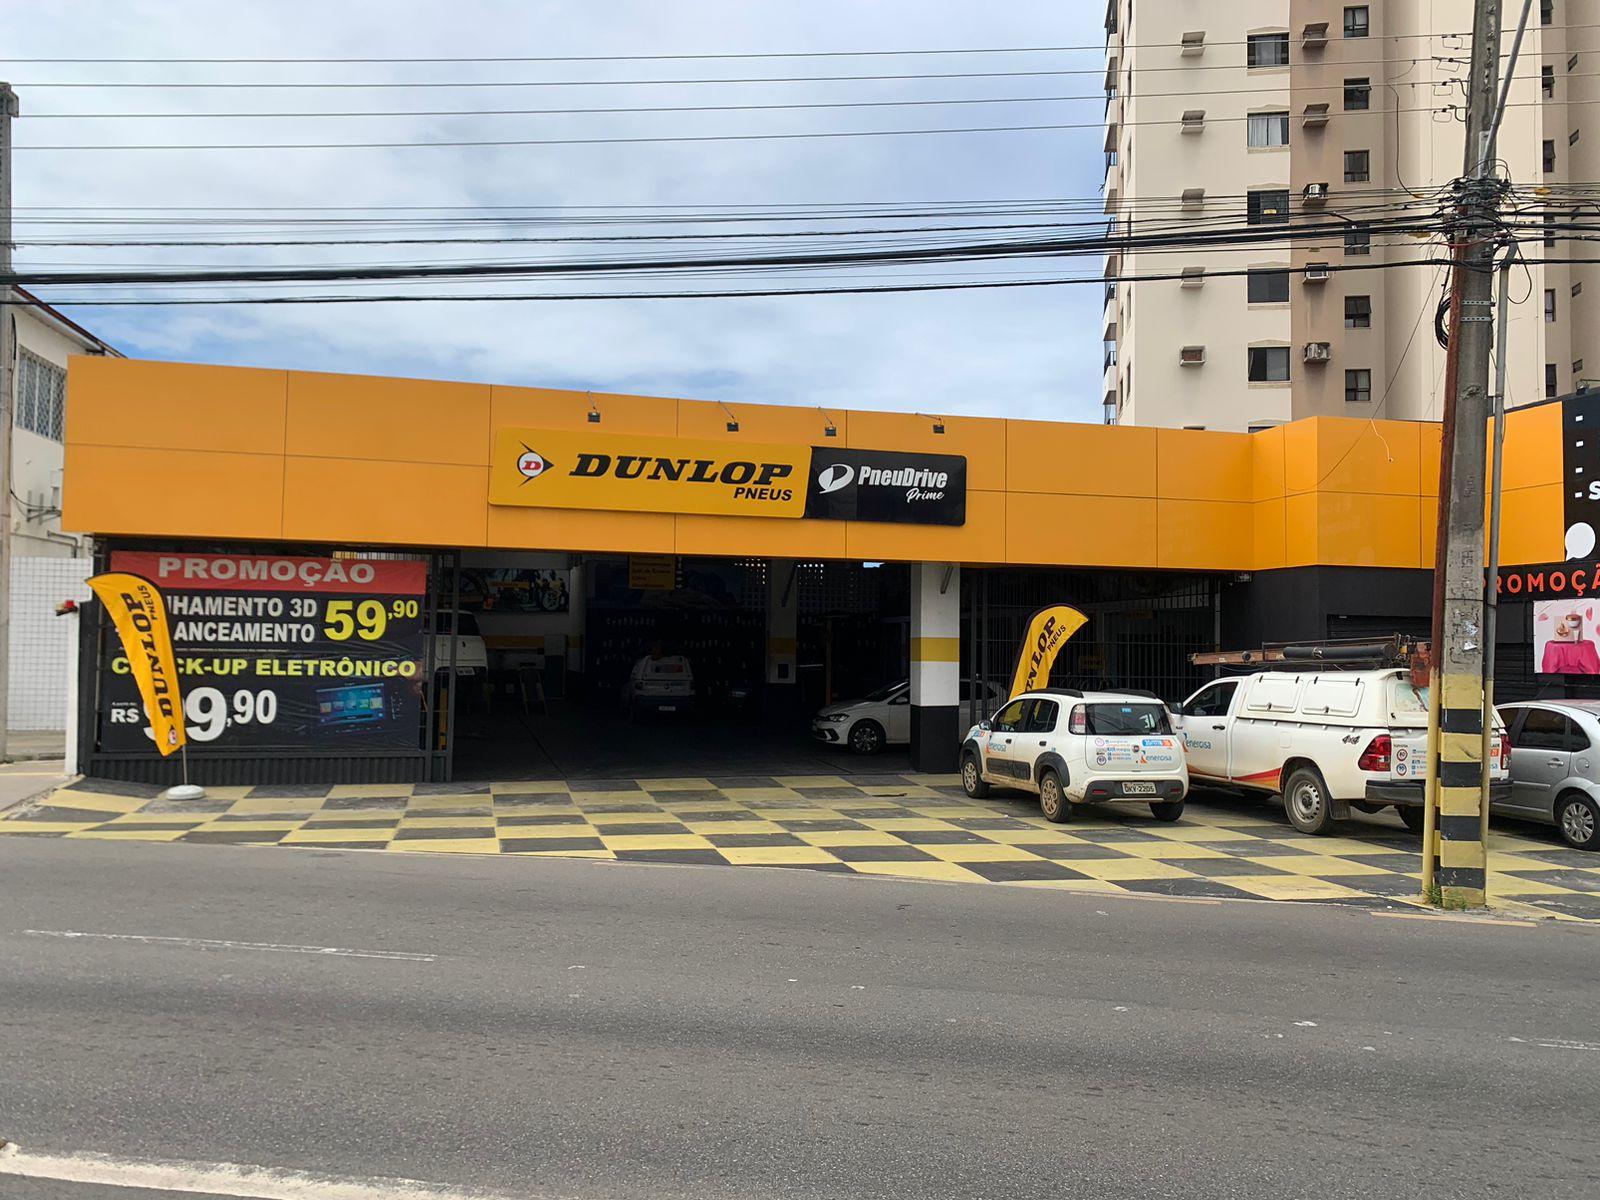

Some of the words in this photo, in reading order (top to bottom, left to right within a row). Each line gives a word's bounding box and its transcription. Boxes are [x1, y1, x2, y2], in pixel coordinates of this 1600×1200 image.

[569, 453, 793, 485] DUNLOP
[858, 466, 948, 488] PneuDrive
[733, 487, 793, 501] PNEUS
[906, 488, 945, 503] Prime
[158, 554, 376, 586] PROMOÇÃO
[138, 585, 158, 620] PNEUS
[289, 599, 317, 618] 3D
[324, 599, 418, 641] 59,90
[1047, 625, 1067, 652] PNEUS
[121, 592, 174, 717] DUNLOP
[255, 654, 416, 678] ELETRÔNICO
